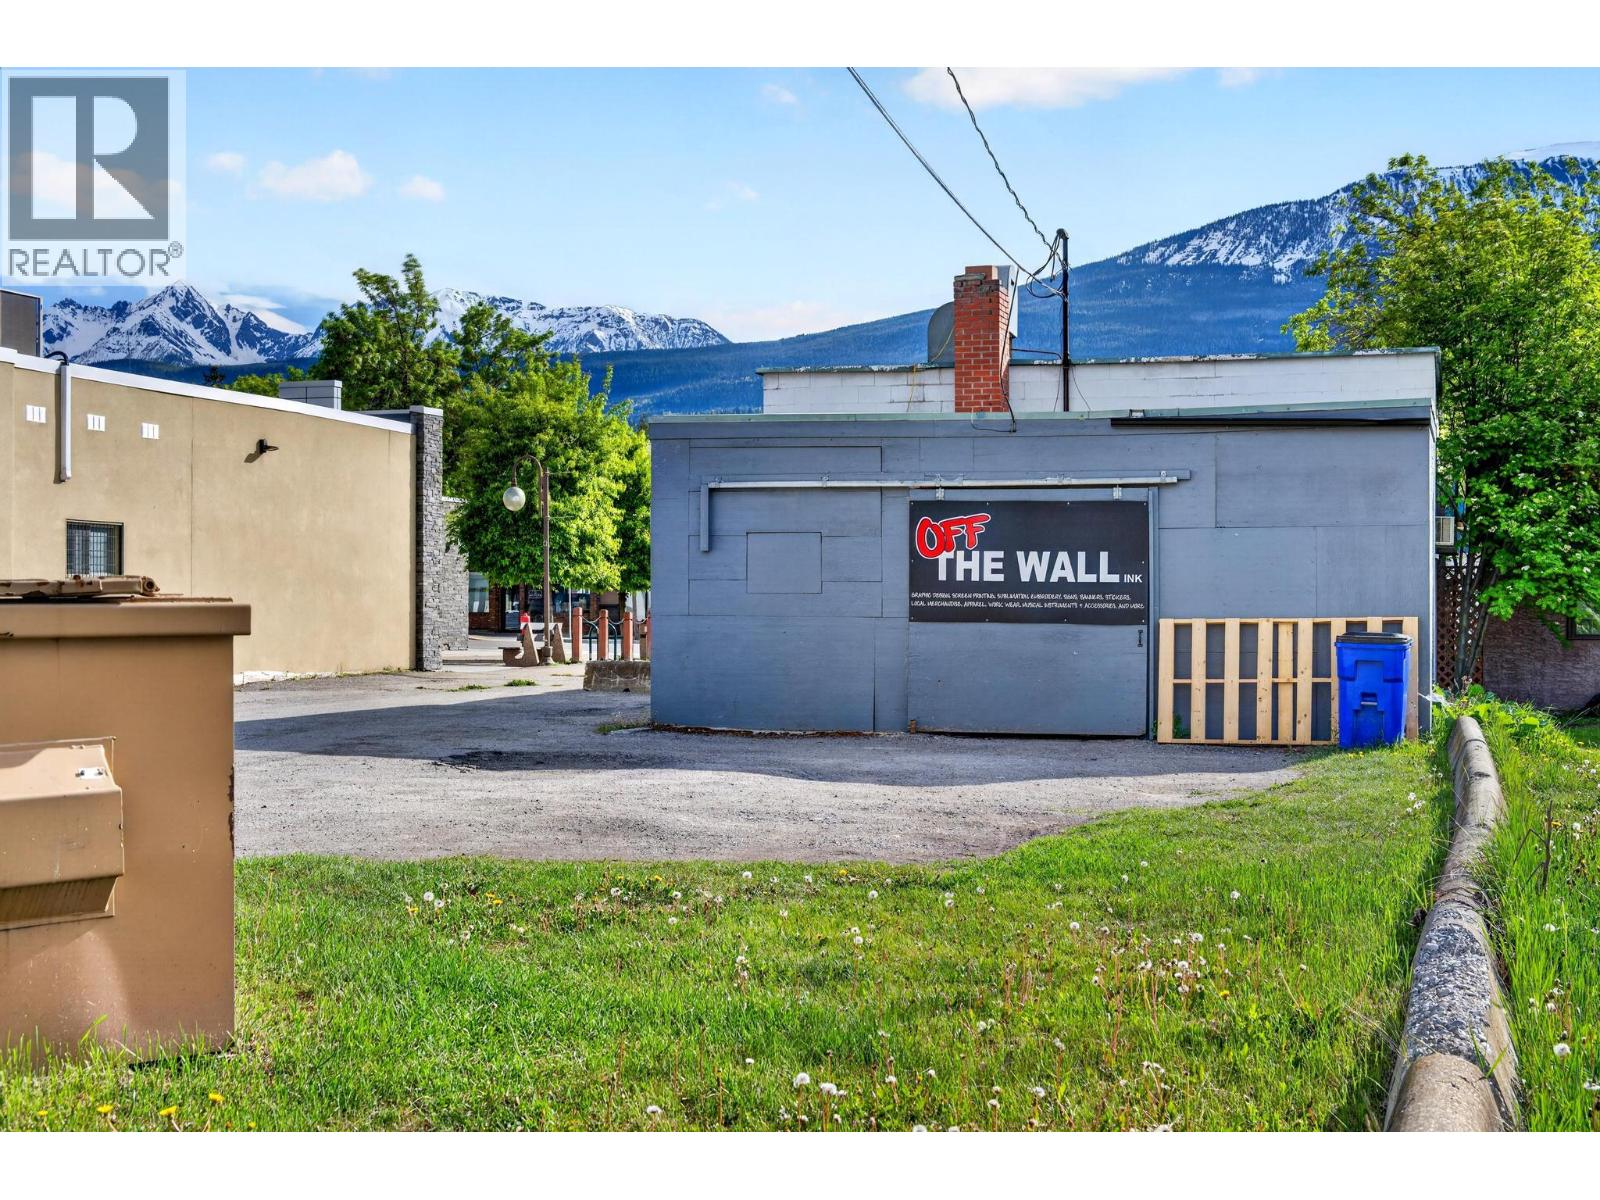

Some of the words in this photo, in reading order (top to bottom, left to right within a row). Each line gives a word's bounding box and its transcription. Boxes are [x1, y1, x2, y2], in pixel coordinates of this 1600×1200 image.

[915, 513, 991, 559] OFF
[937, 550, 1005, 582] THE
[1016, 551, 1120, 583] WALL
[1123, 574, 1143, 583] INK
